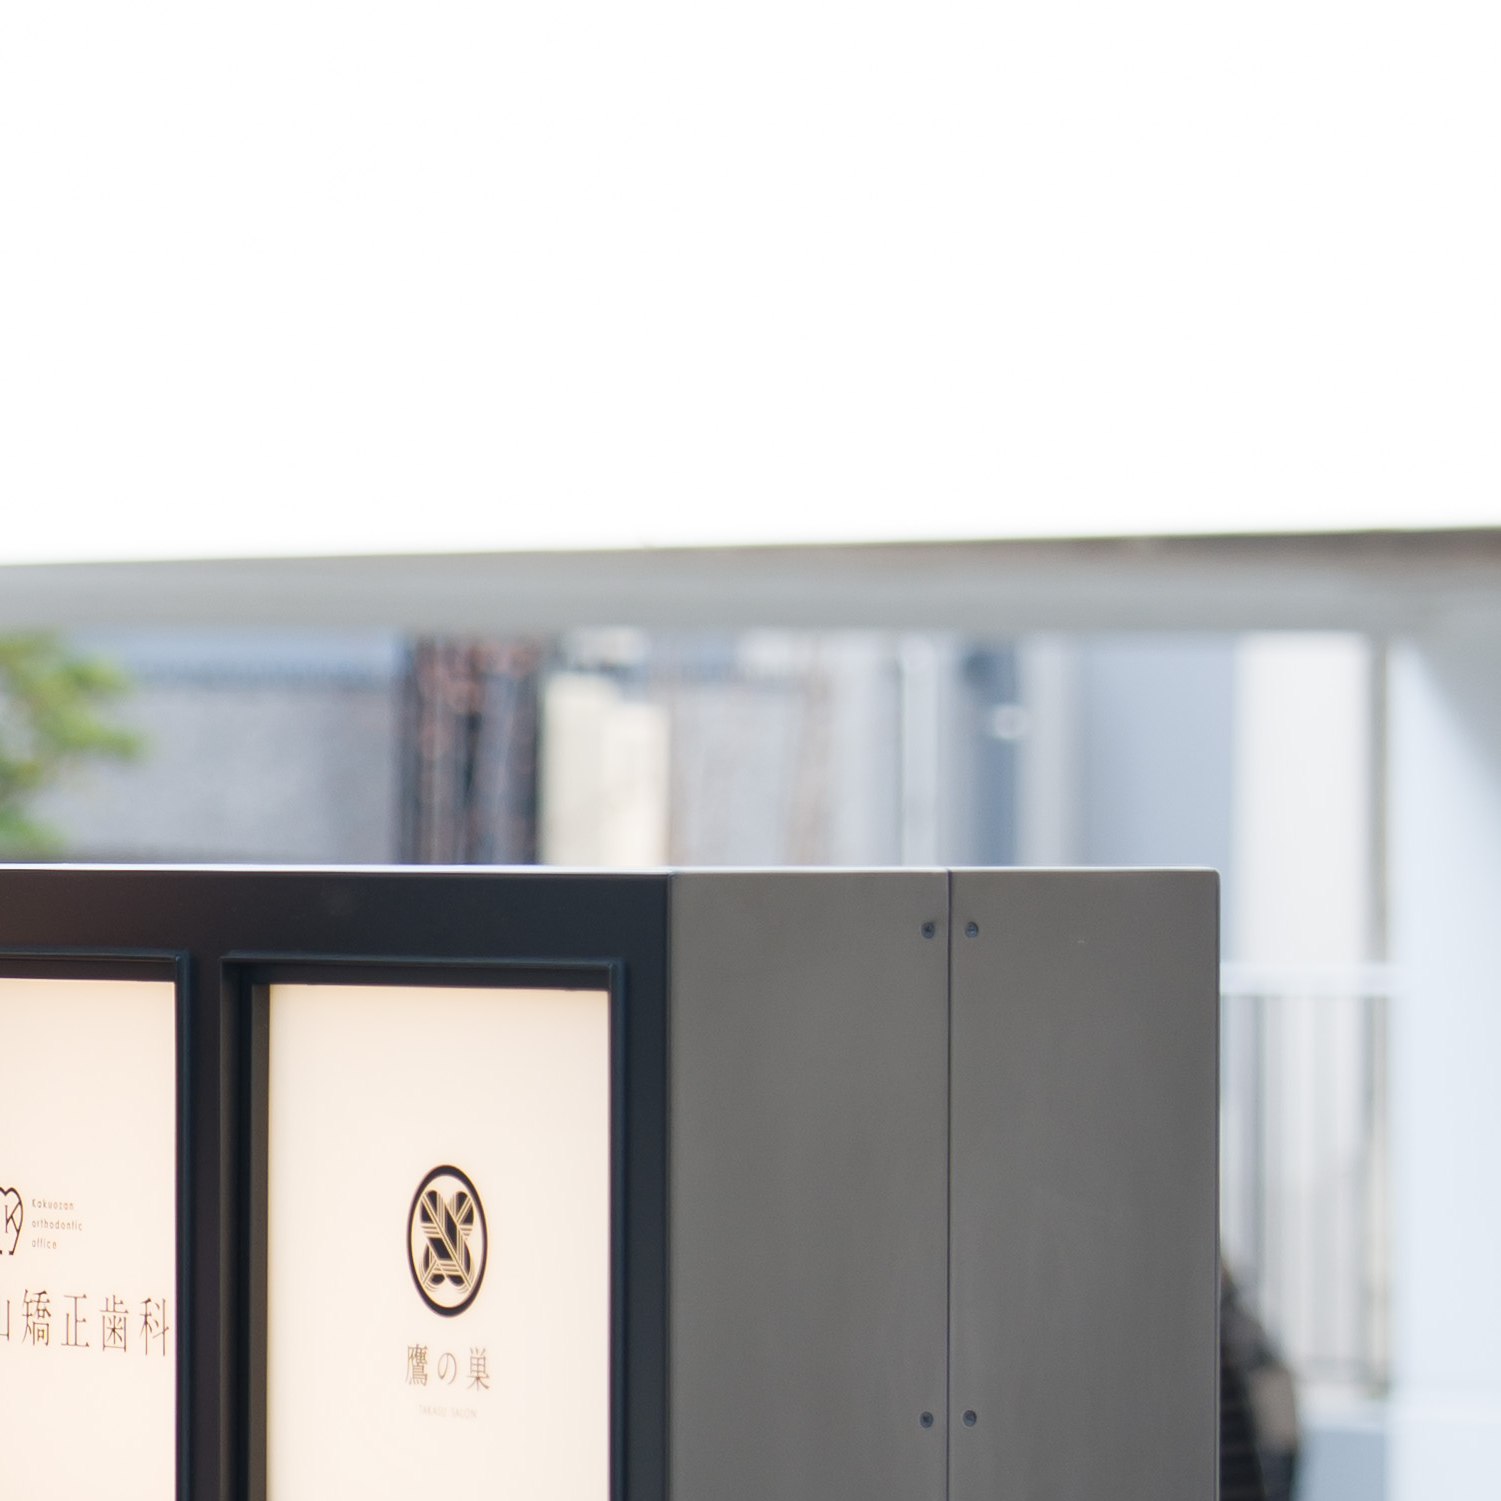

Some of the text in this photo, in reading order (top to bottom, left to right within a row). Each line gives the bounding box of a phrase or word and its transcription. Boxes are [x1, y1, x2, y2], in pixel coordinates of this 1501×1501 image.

[31, 1199, 74, 1211] Kakuozan
[31, 1219, 83, 1232] orthodontic
[31, 1238, 57, 1250] office
[406, 1344, 490, 1391] 鷹の巣
